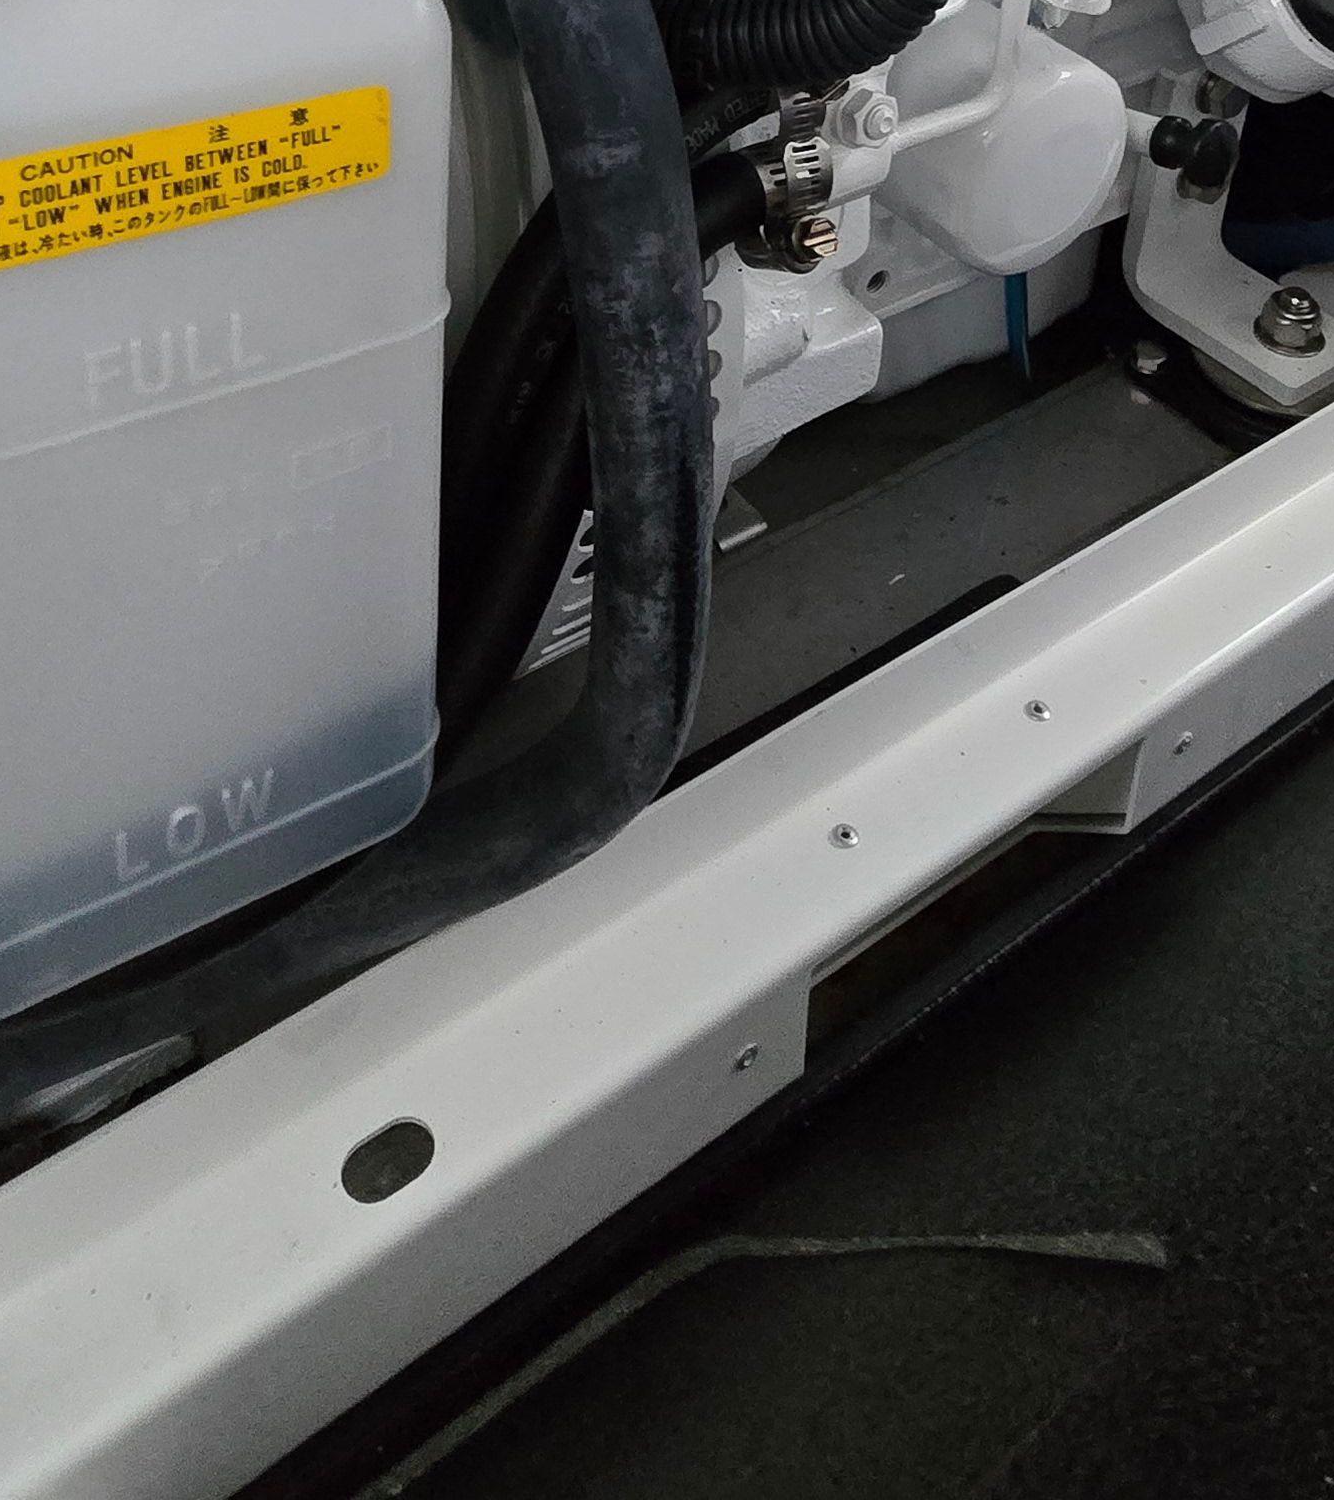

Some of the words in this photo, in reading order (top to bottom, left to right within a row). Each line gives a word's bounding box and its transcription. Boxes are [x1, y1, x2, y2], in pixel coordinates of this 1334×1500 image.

[18, 174, 103, 208] COOLANT
[115, 160, 173, 188] LEVEL
[184, 139, 268, 173] BETWEEN
[19, 143, 134, 182] CAUTION
[93, 187, 150, 215] WHEN
[161, 171, 223, 201] ENGINE
[233, 165, 250, 184] IS
[261, 154, 308, 178] COLD.
[83, 312, 265, 406] FULL
[113, 767, 275, 882] LOW
